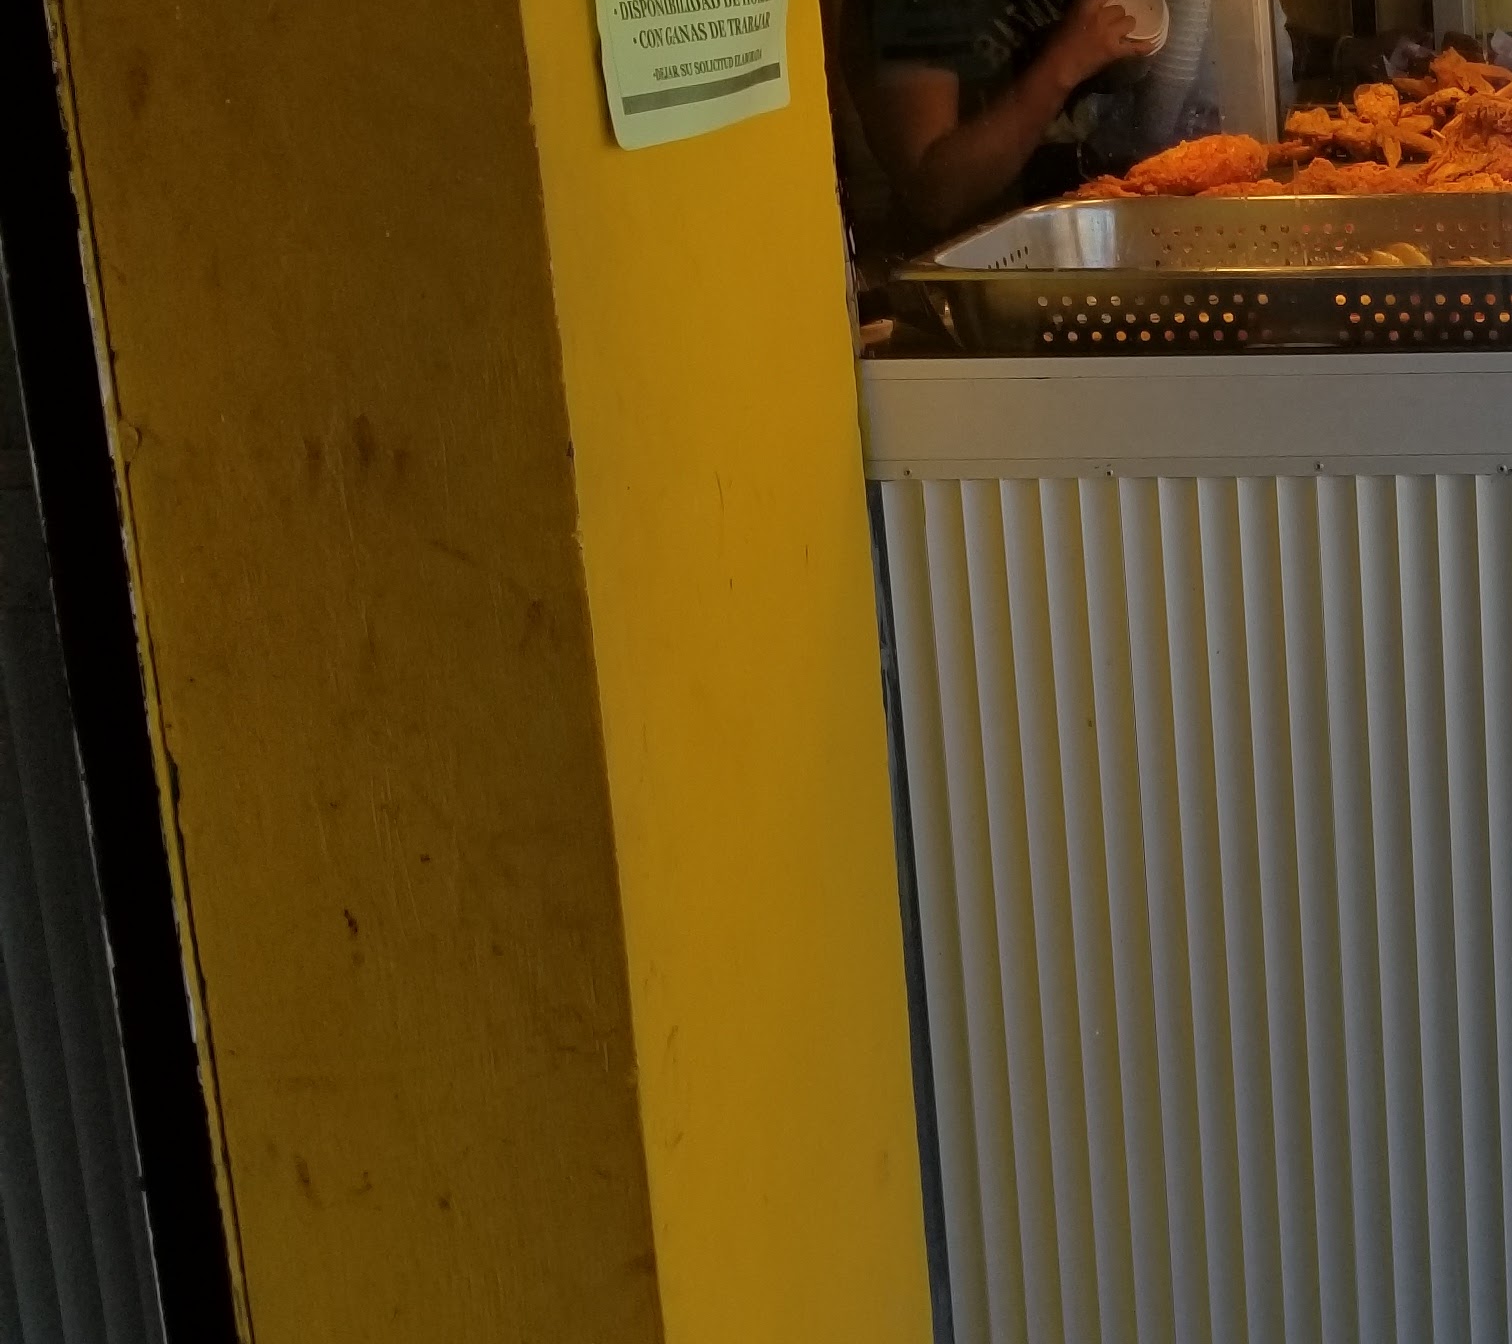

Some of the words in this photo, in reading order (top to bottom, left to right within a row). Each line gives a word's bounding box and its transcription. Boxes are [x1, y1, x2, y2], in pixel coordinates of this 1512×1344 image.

[639, 29, 665, 49] CON
[665, 22, 708, 47] GANAS
[708, 19, 727, 40] DE
[727, 11, 771, 37] TRABAJAR
[680, 62, 693, 77] SU
[694, 56, 734, 74] SOLICITUD
